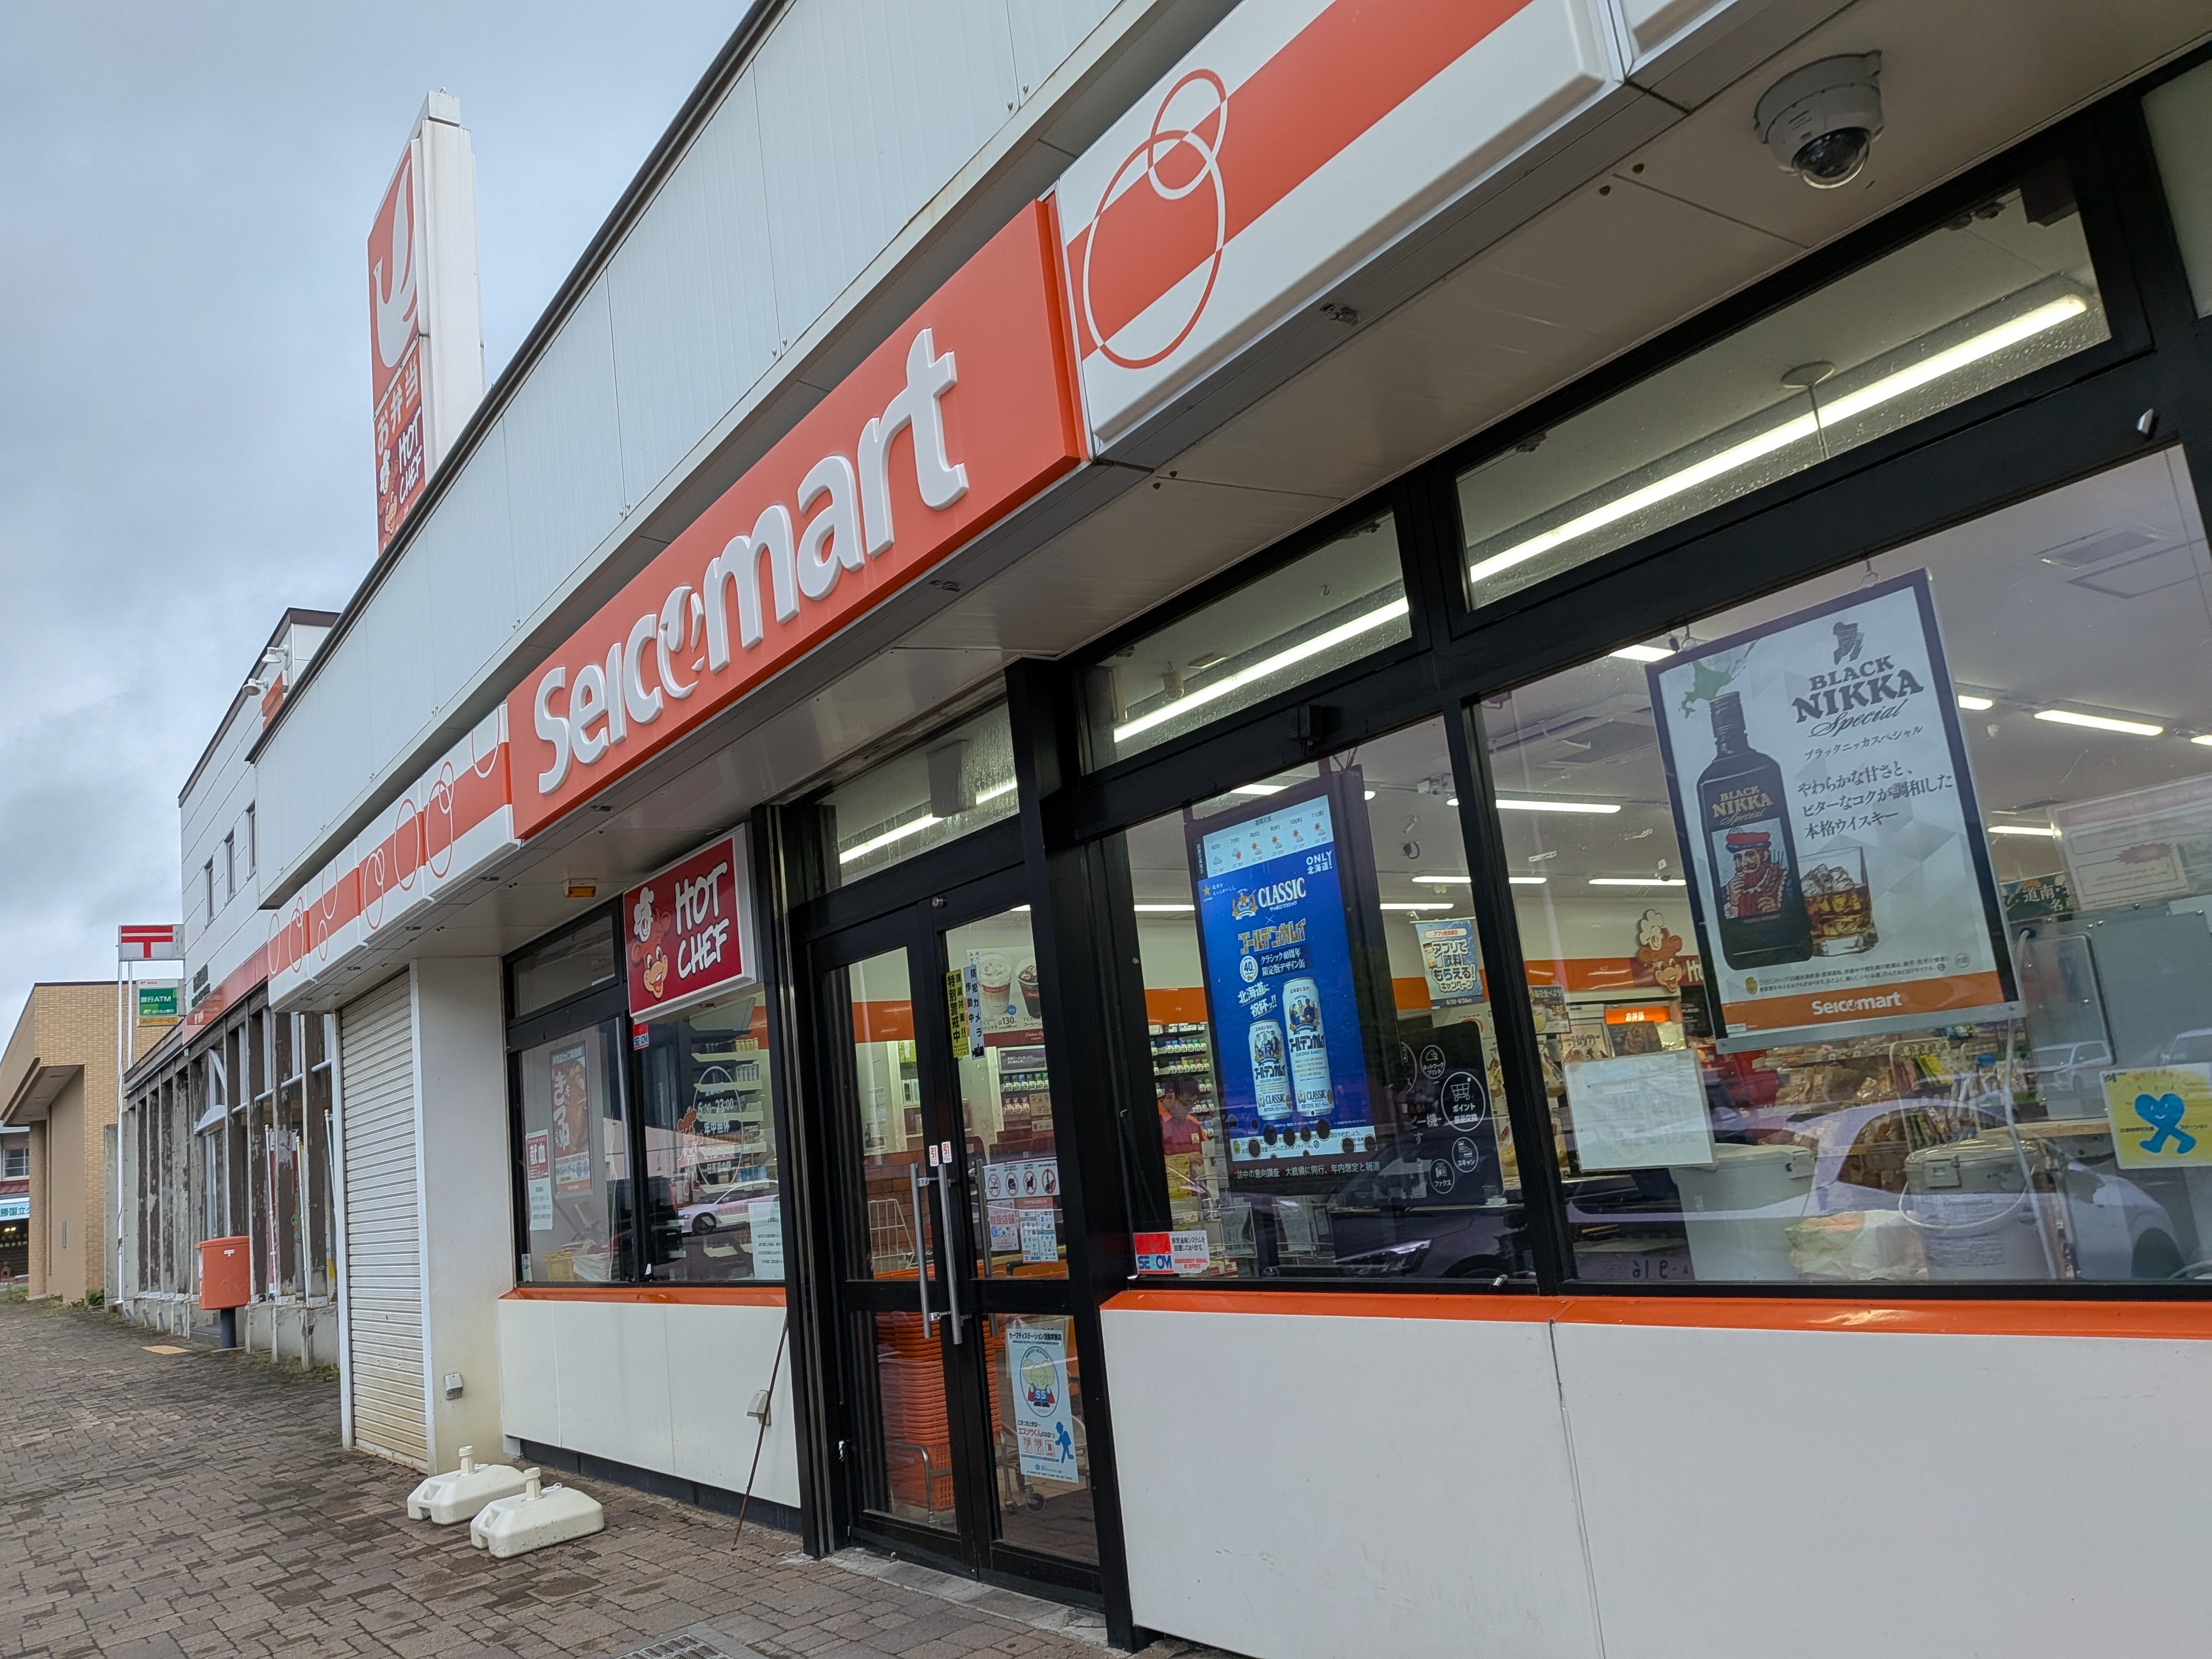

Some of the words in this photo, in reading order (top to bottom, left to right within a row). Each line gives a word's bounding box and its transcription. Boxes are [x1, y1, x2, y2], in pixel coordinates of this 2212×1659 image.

[378, 354, 418, 456] お弁当
[398, 406, 421, 474] HOT
[399, 445, 422, 504] CHEF
[535, 326, 969, 795] Seicomart
[1809, 655, 1894, 691] BLACK
[1792, 669, 1924, 723] NIKKA
[1807, 698, 1908, 738] Special
[1804, 726, 1923, 761] ブラックニッカスペシャル
[1798, 761, 1913, 797] やわらかな甘さと、
[1712, 793, 1773, 818] NIKKA
[1720, 785, 1760, 802] BLACK
[1802, 775, 1953, 817] ビターなコクが調和した
[1719, 807, 1767, 826] Special
[1803, 812, 1900, 839] 本格ウイスキー
[1306, 849, 1333, 866] ONLY
[675, 861, 728, 935] HOT
[1258, 877, 1307, 908] CLASSIC
[677, 918, 730, 979] CHEF
[1238, 918, 1306, 955] ゴールデンカムイ
[1261, 947, 1301, 965] クラシック40周年
[1432, 942, 1467, 958] アプリで
[1443, 954, 1462, 967] 飲料
[1262, 959, 1306, 977] 限定版デザイン缶
[1433, 965, 1475, 982] もらえる!
[1238, 981, 1270, 1005] 北海道に
[1440, 982, 1473, 992] キャンペーン
[947, 974, 961, 1044] 特別警戒中
[966, 982, 974, 1023] 作動中
[971, 968, 982, 1037] 防犯カメラ
[1811, 992, 1902, 1015] Seicomart
[1001, 1016, 1015, 1025] 130
[1265, 1093, 1286, 1104] CLASSIC
[1306, 1089, 1327, 1100] CLASSIC
[1452, 1104, 1476, 1113] ポイント
[1285, 1162, 1381, 1176] 大統領に同行、年内想定と報道
[1138, 1255, 1172, 1270] SECOM
[1035, 1390, 1046, 1399] SS
